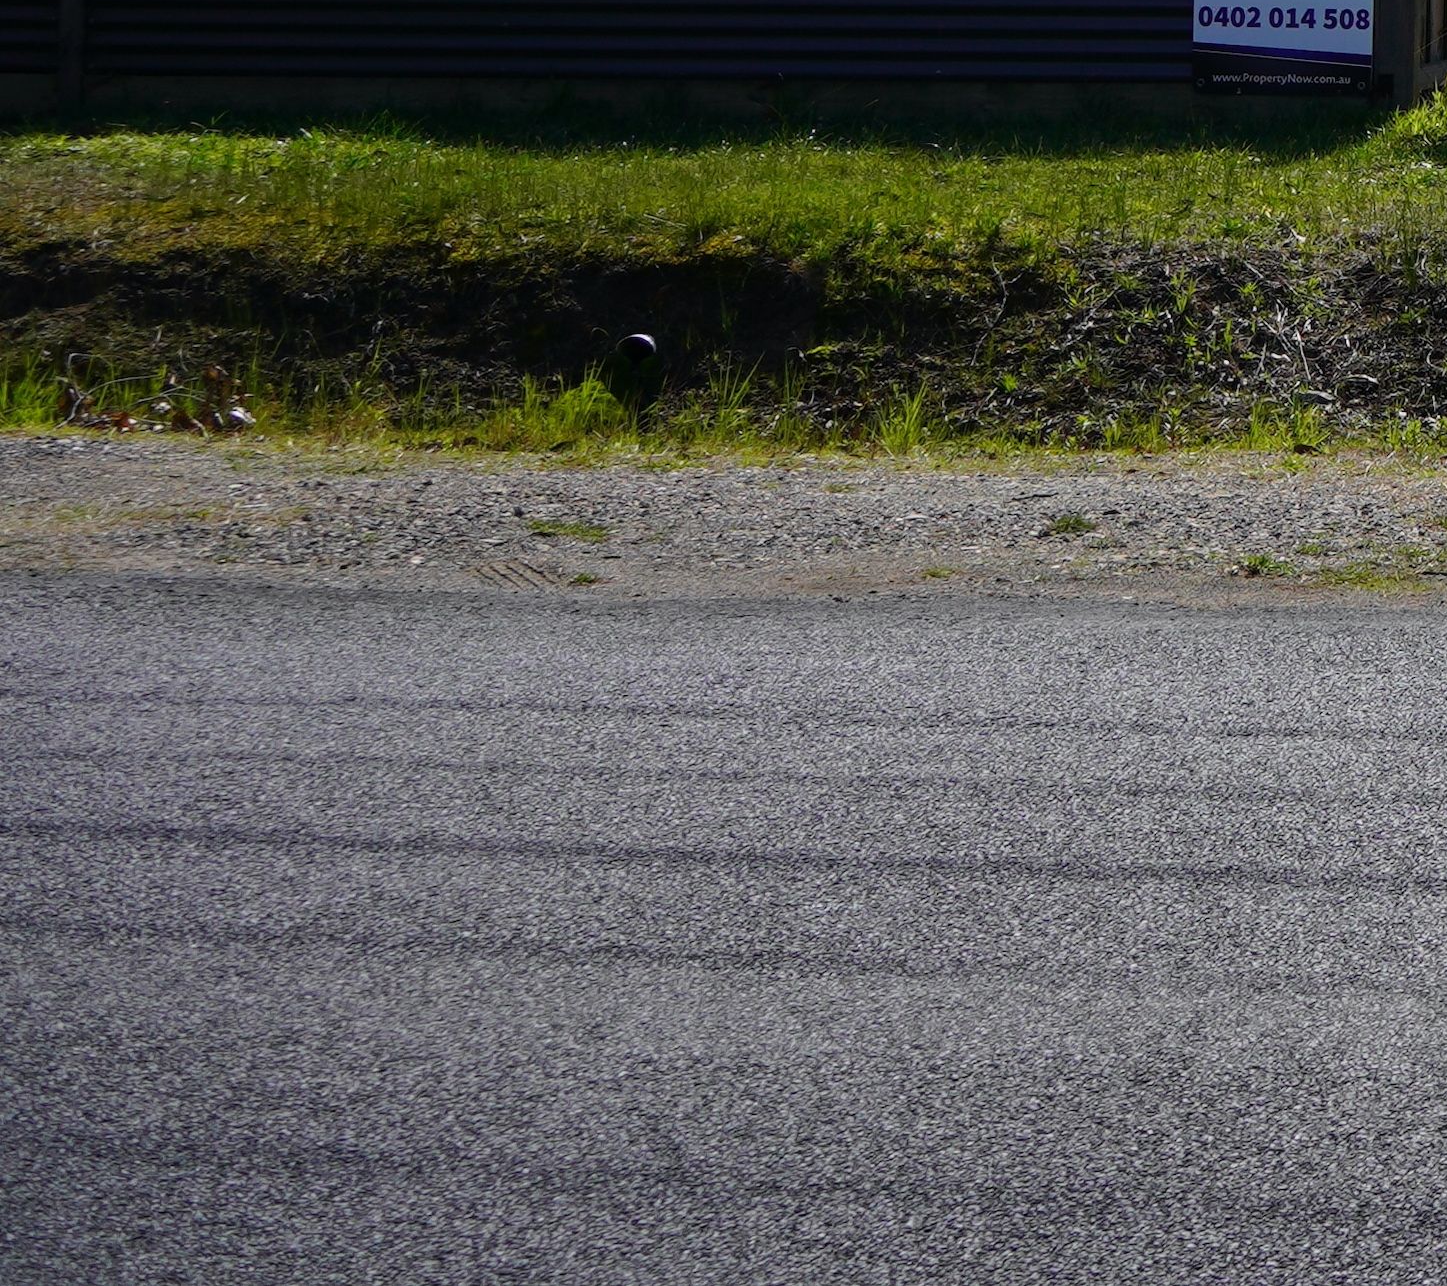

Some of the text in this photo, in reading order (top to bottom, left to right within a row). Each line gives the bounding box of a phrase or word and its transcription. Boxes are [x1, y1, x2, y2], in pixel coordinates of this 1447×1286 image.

[1198, 6, 1371, 30] 0402 014 508
[1212, 73, 1352, 86] www.PropertyNow.com.au
